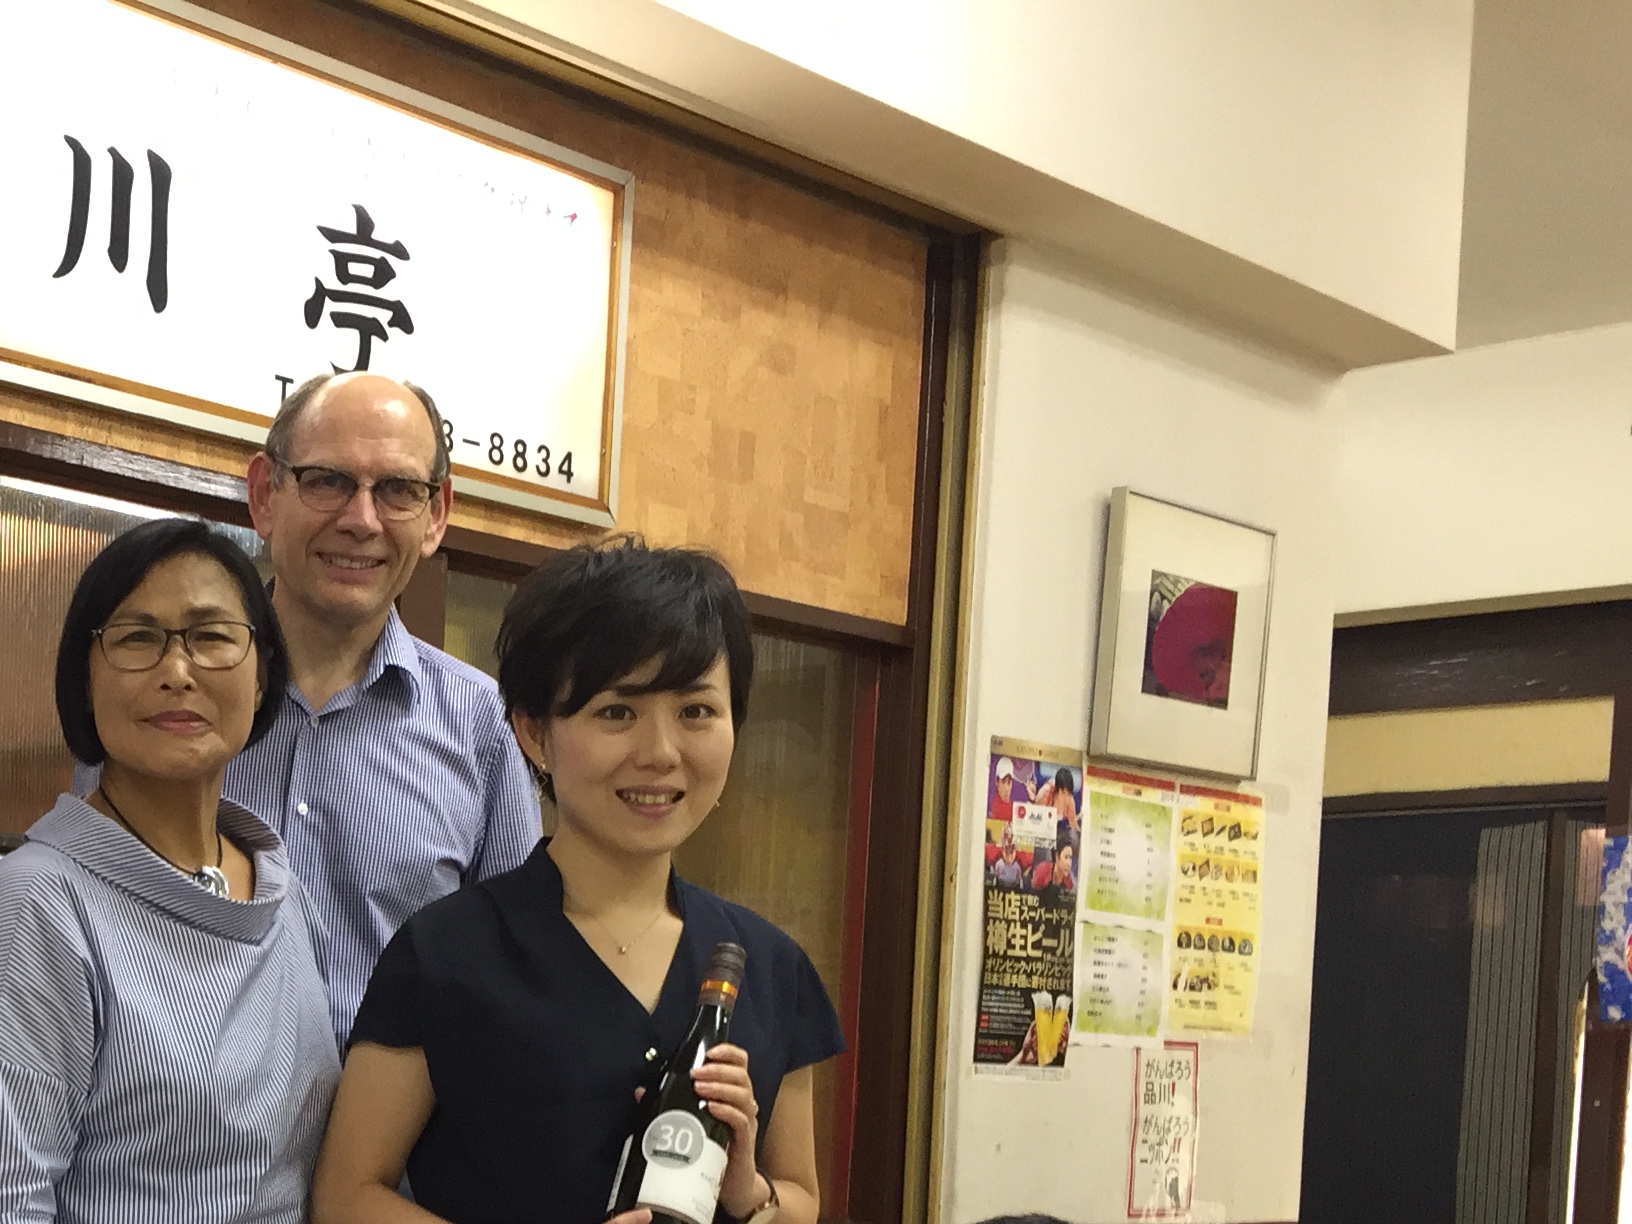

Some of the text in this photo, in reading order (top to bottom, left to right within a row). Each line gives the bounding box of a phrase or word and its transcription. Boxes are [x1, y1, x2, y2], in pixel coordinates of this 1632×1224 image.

[987, 889, 1021, 920] 当店
[1020, 906, 1075, 926] スーパードライ
[986, 919, 1074, 958] 樽生ビール
[1144, 1058, 1192, 1081] がんばろう
[1143, 1081, 1176, 1107] 品川!
[1142, 1114, 1190, 1137] がんばろう
[655, 1124, 694, 1155] 30
